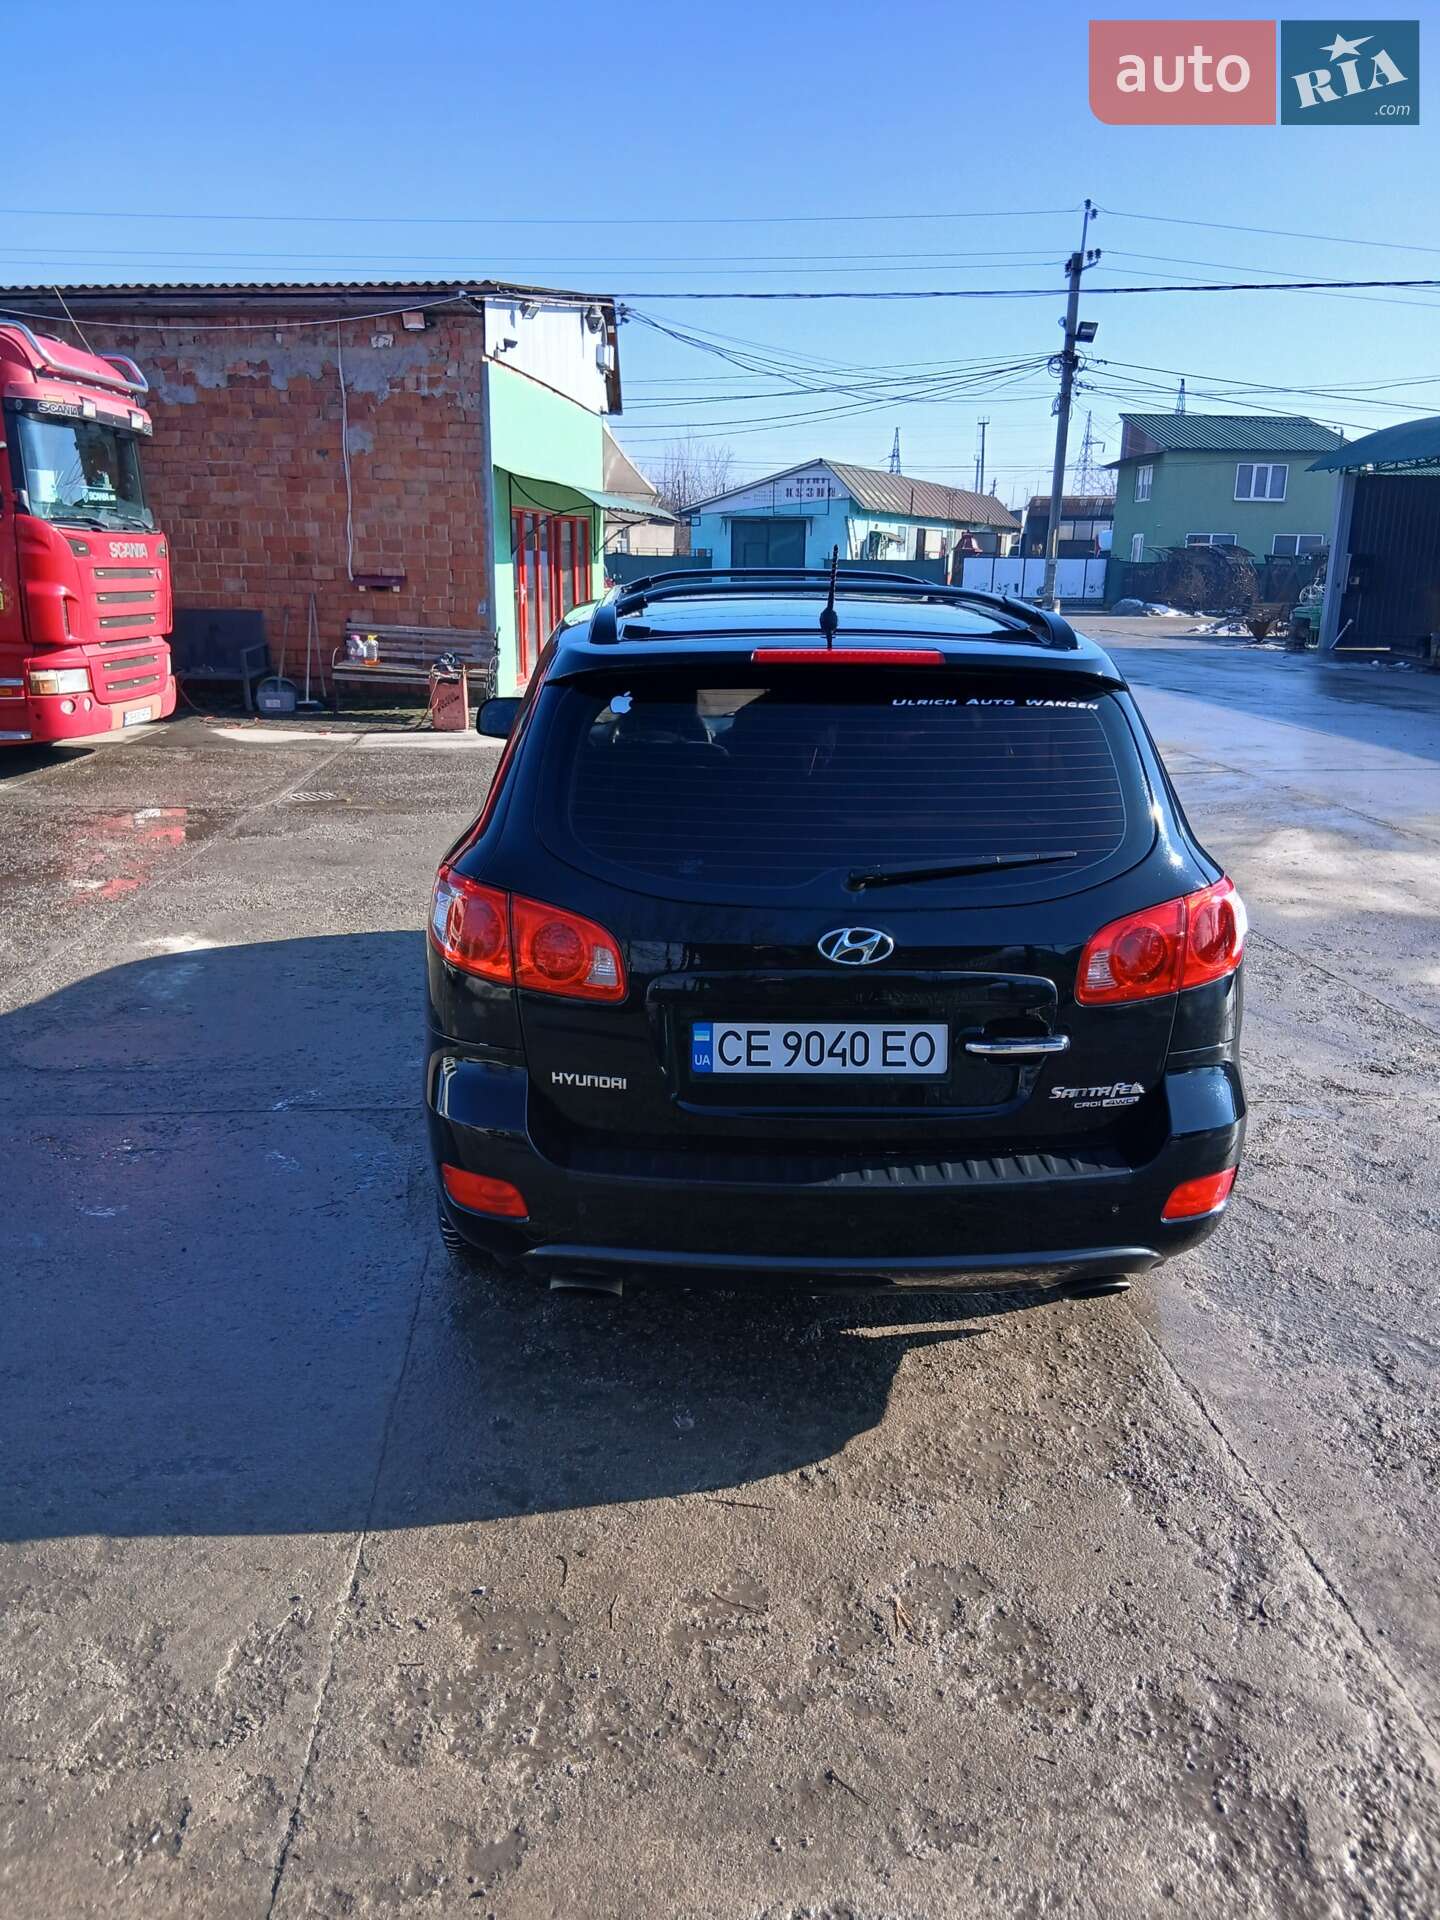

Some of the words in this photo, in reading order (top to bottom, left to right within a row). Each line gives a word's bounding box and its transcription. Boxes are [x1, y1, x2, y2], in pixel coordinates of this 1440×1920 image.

[37, 401, 79, 417] SCANIA
[108, 542, 149, 558] SCANIA
[892, 698, 957, 706] ULRICH
[965, 698, 1016, 706] AUTO
[717, 1030, 772, 1067] CE
[782, 1030, 870, 1067] 9040
[881, 1030, 936, 1067] EO
[694, 1054, 711, 1066] UA
[551, 1071, 627, 1090] HYUNDAI
